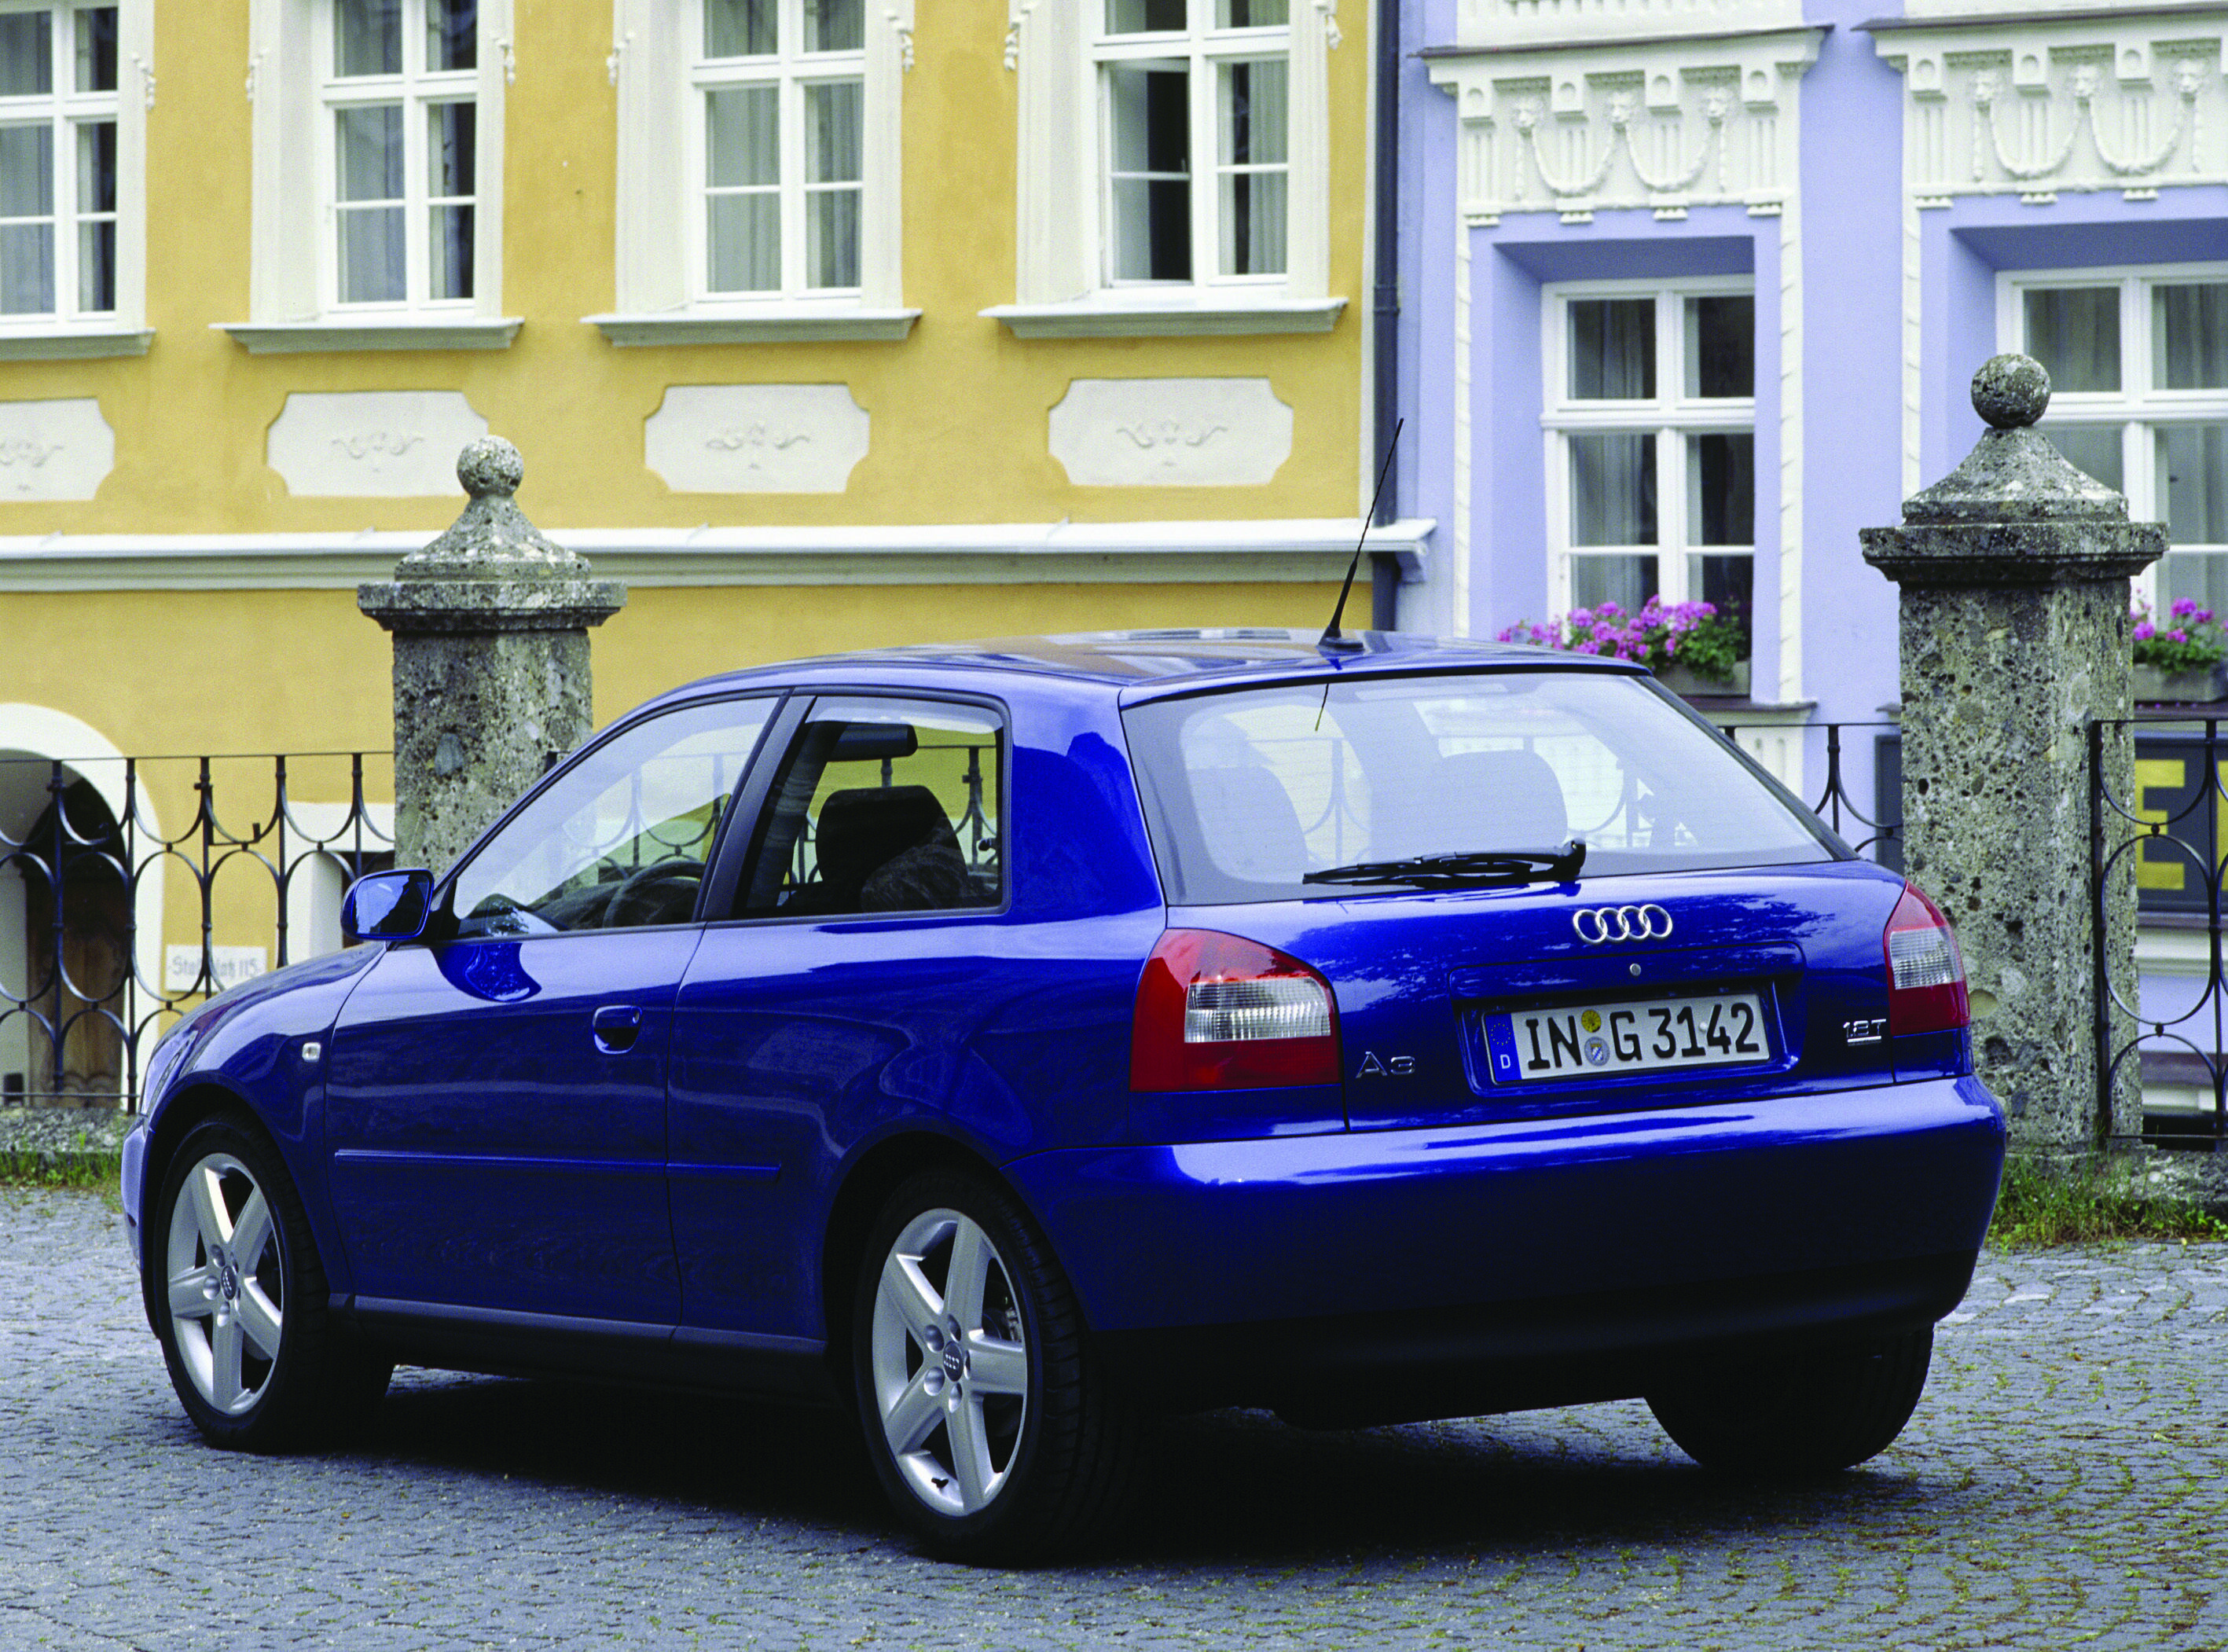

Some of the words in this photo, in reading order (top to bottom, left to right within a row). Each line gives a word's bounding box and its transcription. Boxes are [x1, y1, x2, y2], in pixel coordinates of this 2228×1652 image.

[1525, 1015, 1583, 1070] IN
[1356, 1051, 1415, 1078] A3
[1499, 1054, 1511, 1070] D
